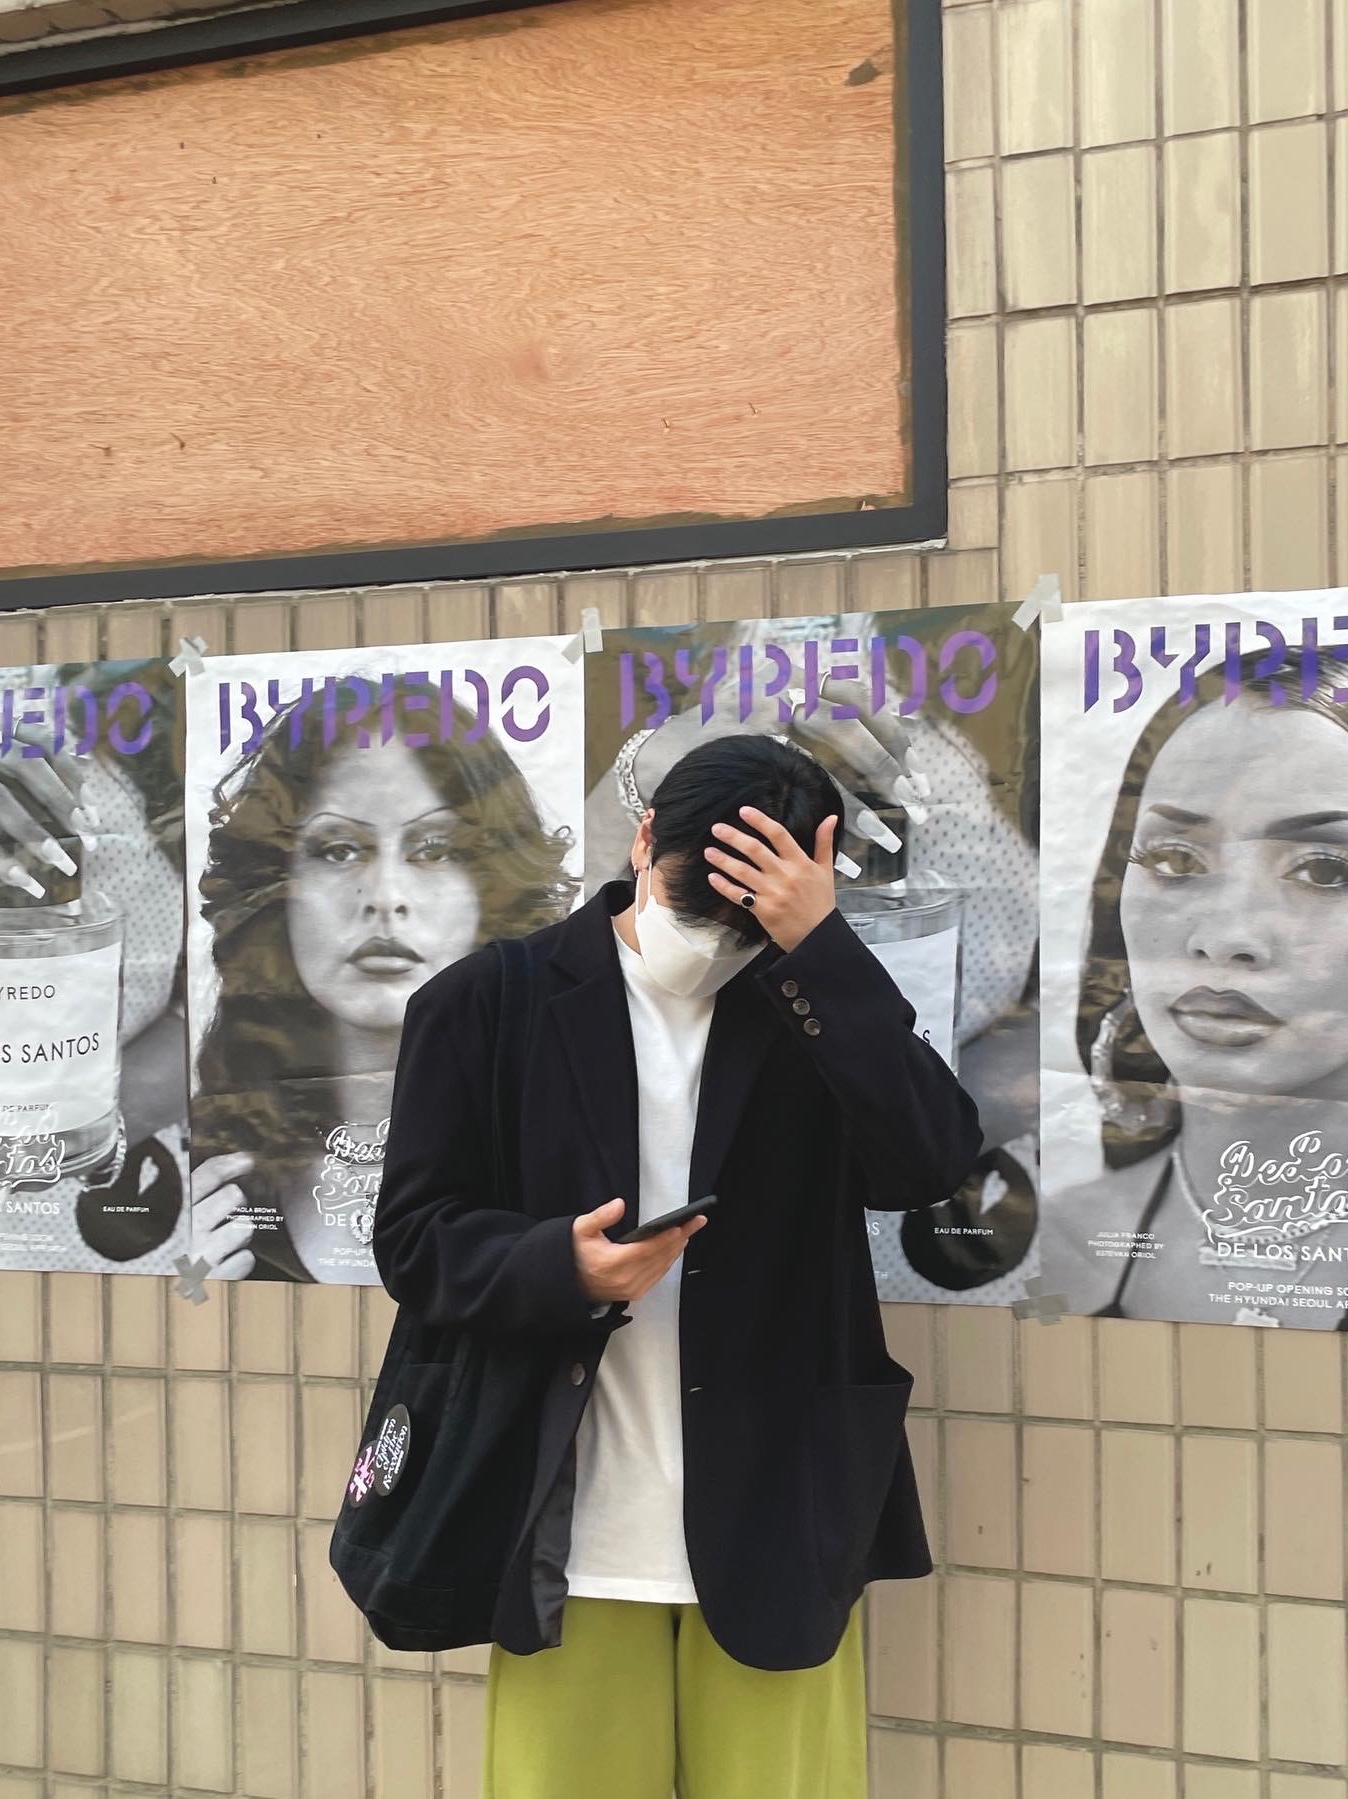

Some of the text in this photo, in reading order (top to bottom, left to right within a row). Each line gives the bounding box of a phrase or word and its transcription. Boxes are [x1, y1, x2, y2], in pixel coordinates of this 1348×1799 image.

[620, 630, 998, 729] BYREDO
[219, 666, 550, 755] BYREDO
[21, 1032, 99, 1063] SANTOS
[6, 1201, 60, 1215] SANTOS
[325, 1213, 347, 1226] DE
[951, 1227, 961, 1235] DE
[963, 1228, 993, 1236] PARFUM
[1217, 1242, 1247, 1258] DE
[1253, 1243, 1294, 1260] LOS
[1228, 1281, 1274, 1293] POP-UP
[1276, 1284, 1333, 1296] OPENING
[1208, 1293, 1232, 1303] THE
[1234, 1295, 1289, 1306] HYUNDAI
[1292, 1297, 1333, 1309] SEOUL
